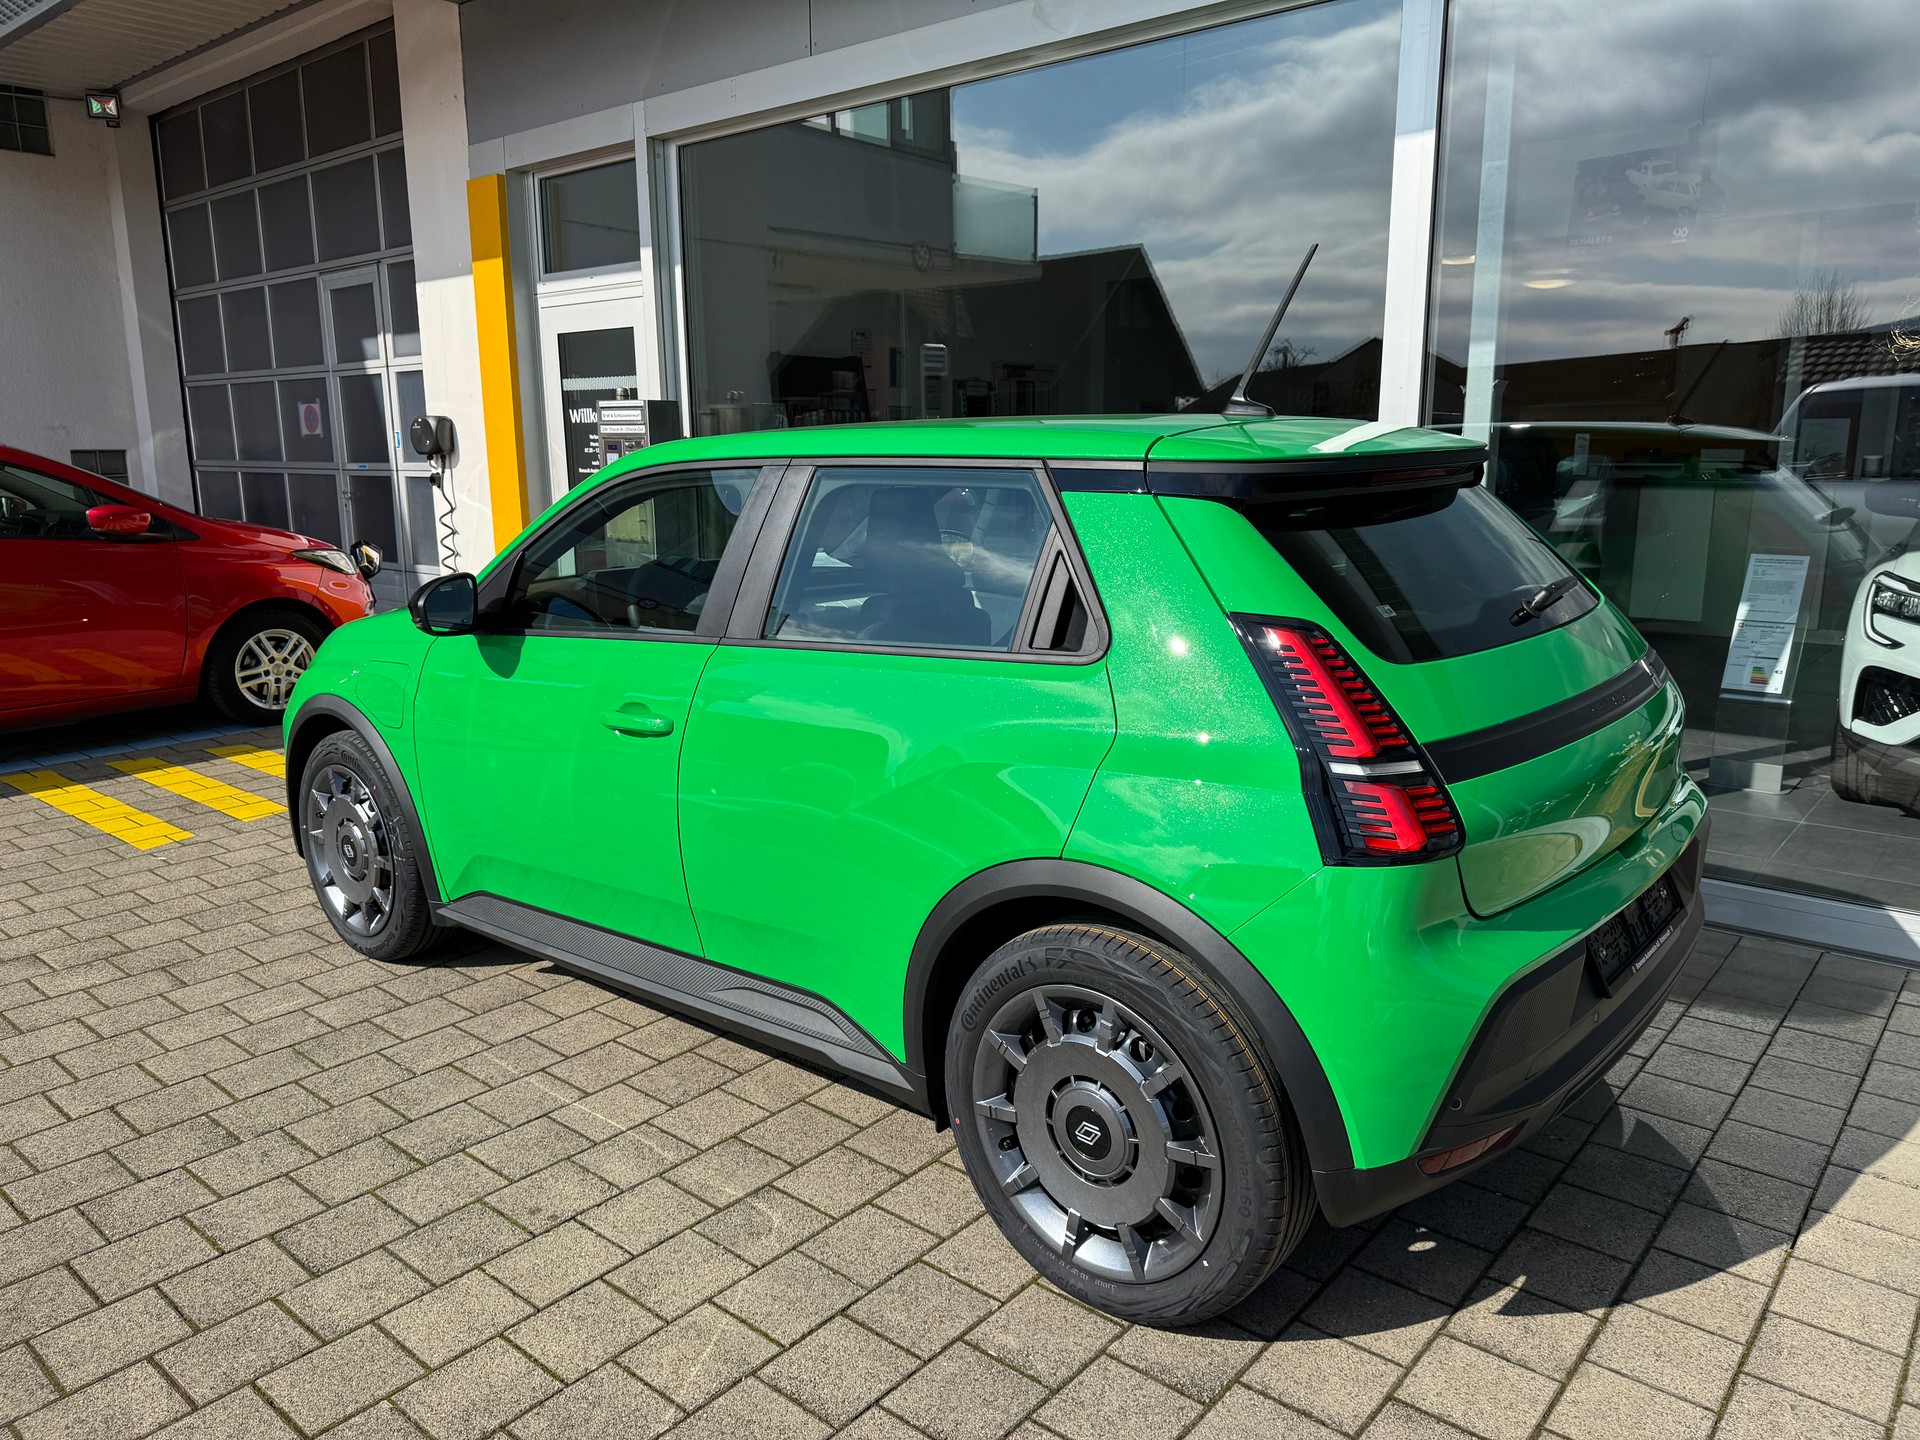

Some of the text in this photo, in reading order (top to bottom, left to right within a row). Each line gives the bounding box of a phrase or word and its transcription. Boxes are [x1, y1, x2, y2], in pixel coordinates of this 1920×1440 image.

[1569, 236, 1606, 247] RENAULT
[341, 749, 374, 788] Continent
[961, 959, 1026, 1032] Continental
